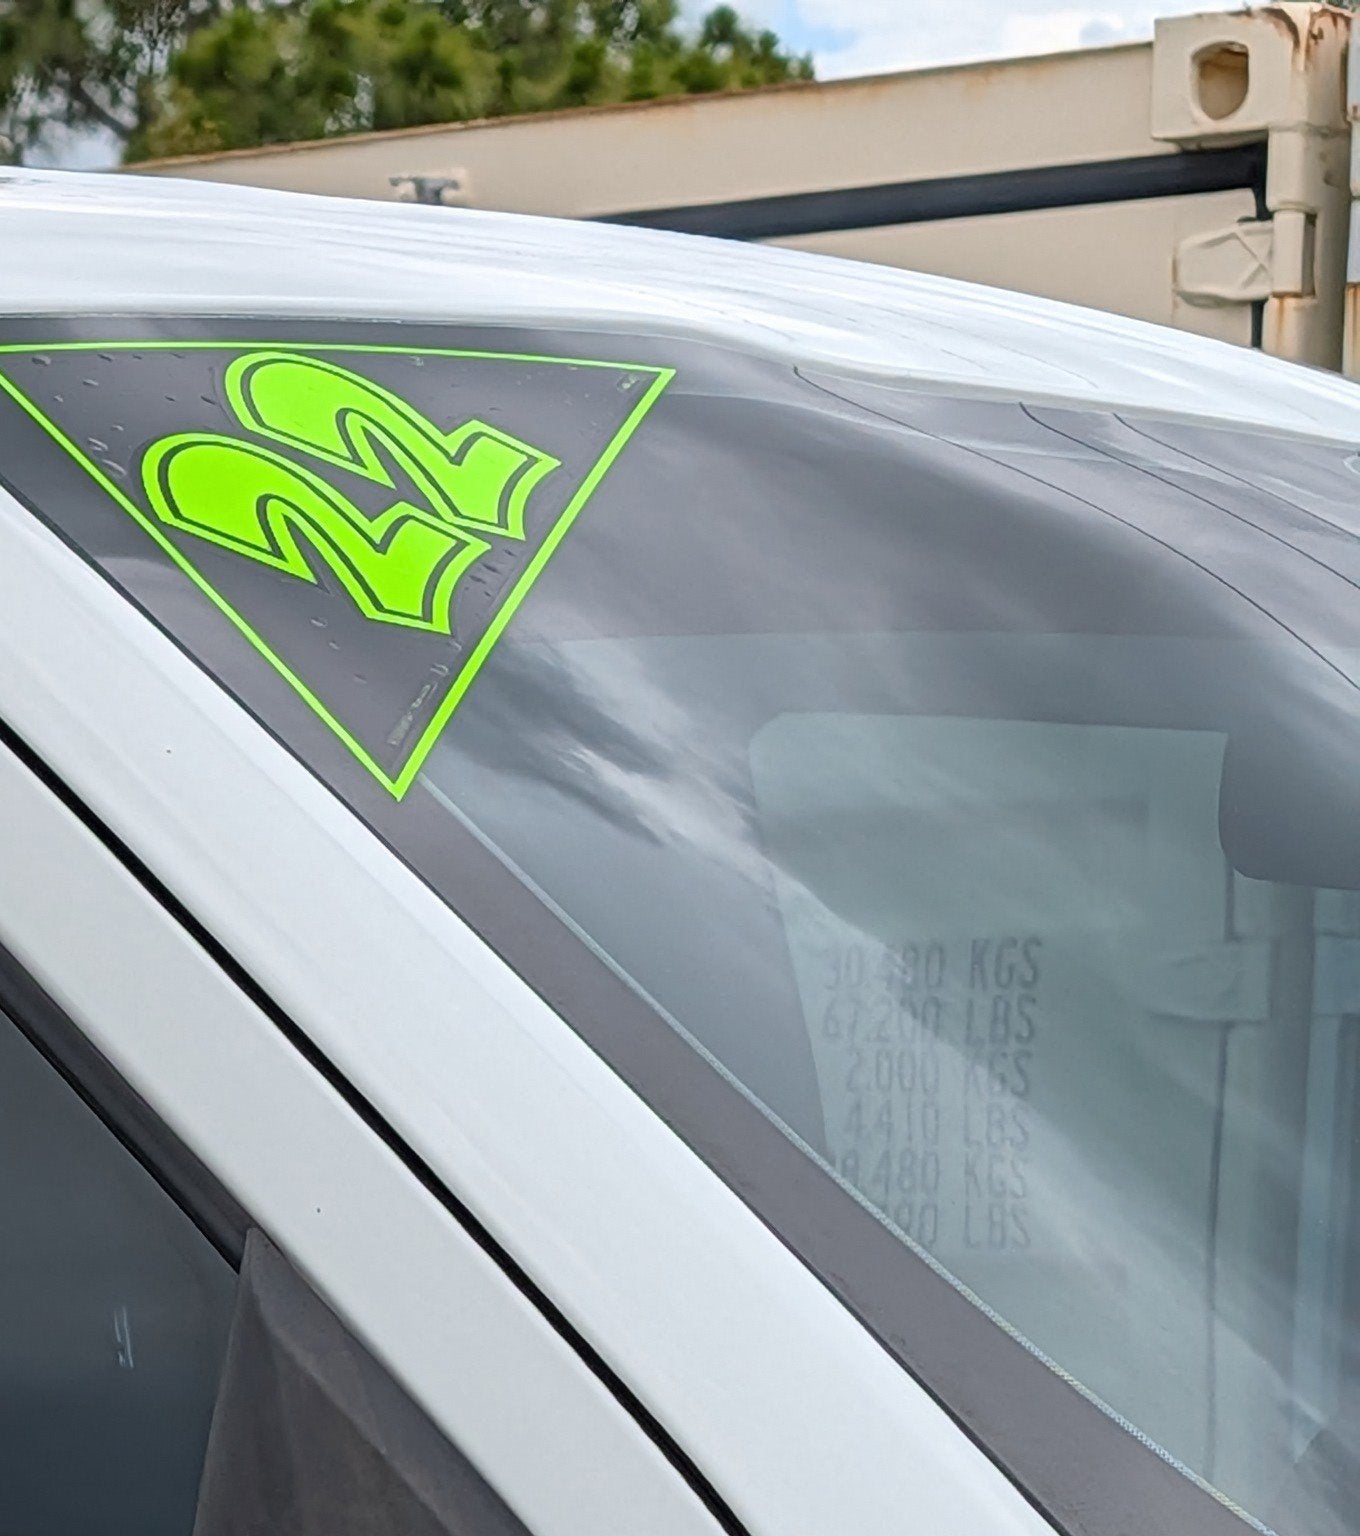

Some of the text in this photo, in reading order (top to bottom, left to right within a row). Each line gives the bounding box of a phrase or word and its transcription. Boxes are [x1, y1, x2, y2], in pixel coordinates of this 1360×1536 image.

[141, 352, 562, 635] 22
[968, 936, 1043, 990] KGS
[964, 995, 1037, 1046] LBS
[963, 1050, 1033, 1098] KGS
[963, 1101, 1031, 1150] LBS
[963, 1151, 1031, 1199] KGS
[963, 1202, 1032, 1250] LBS
